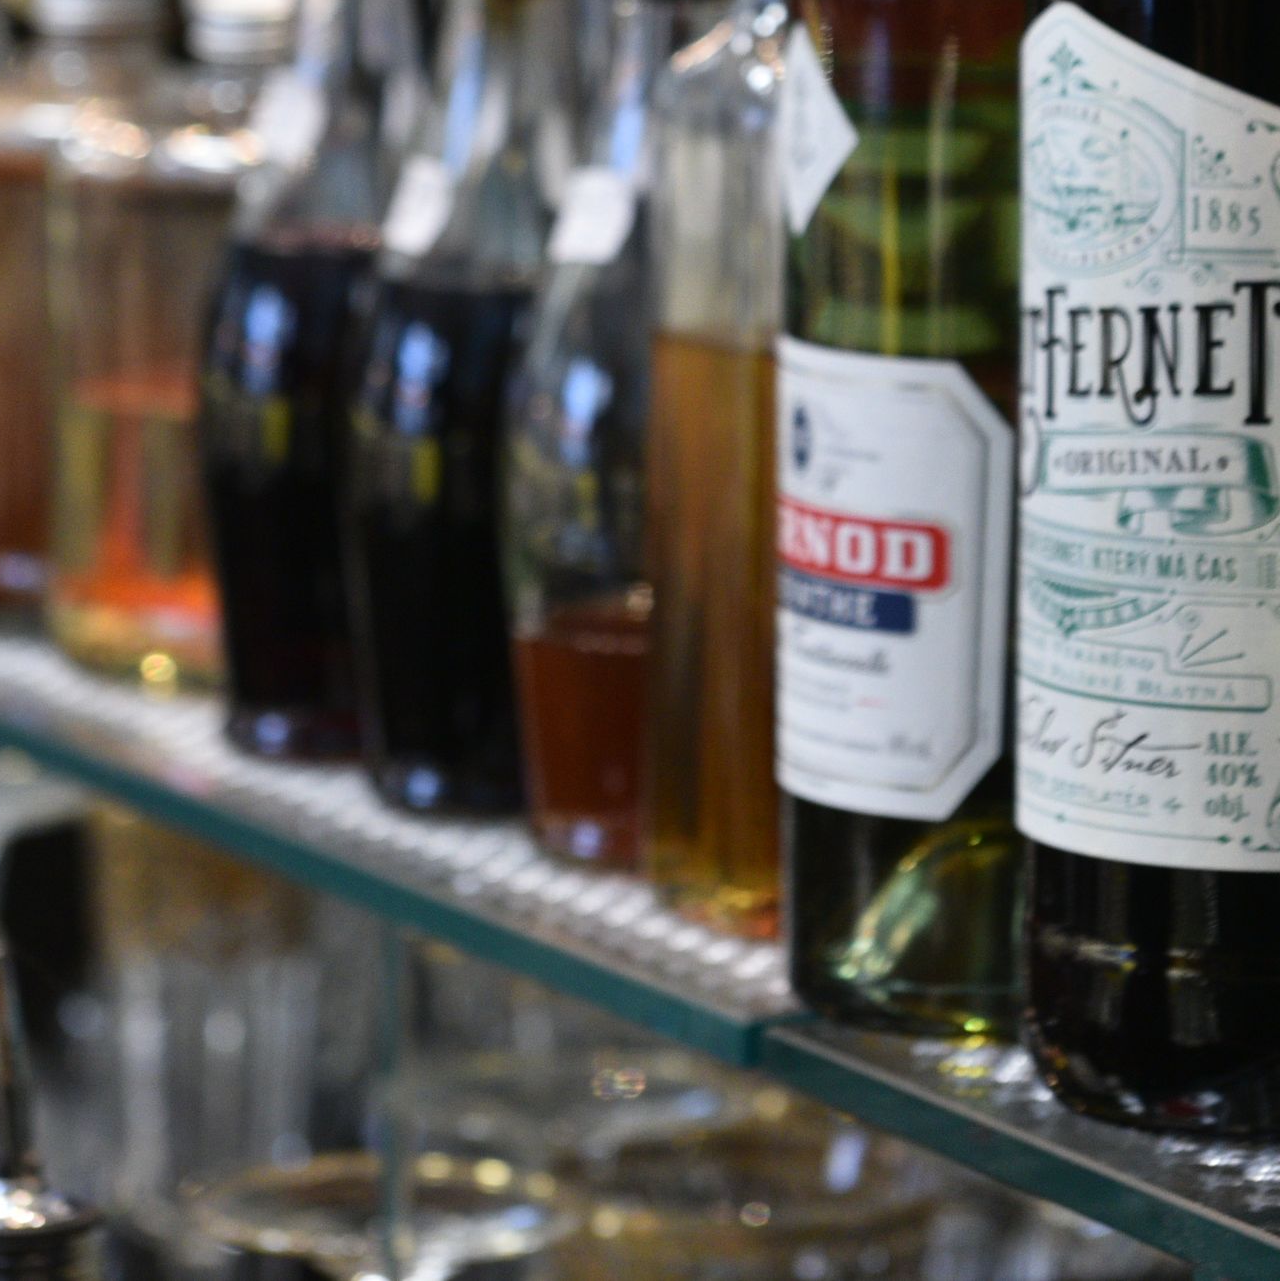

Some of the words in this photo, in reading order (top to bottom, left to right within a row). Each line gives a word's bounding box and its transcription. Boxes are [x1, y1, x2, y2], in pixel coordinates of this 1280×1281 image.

[1190, 192, 1262, 236] 1885
[1062, 446, 1210, 476] ORIGINAL
[1206, 762, 1262, 788] 40%
